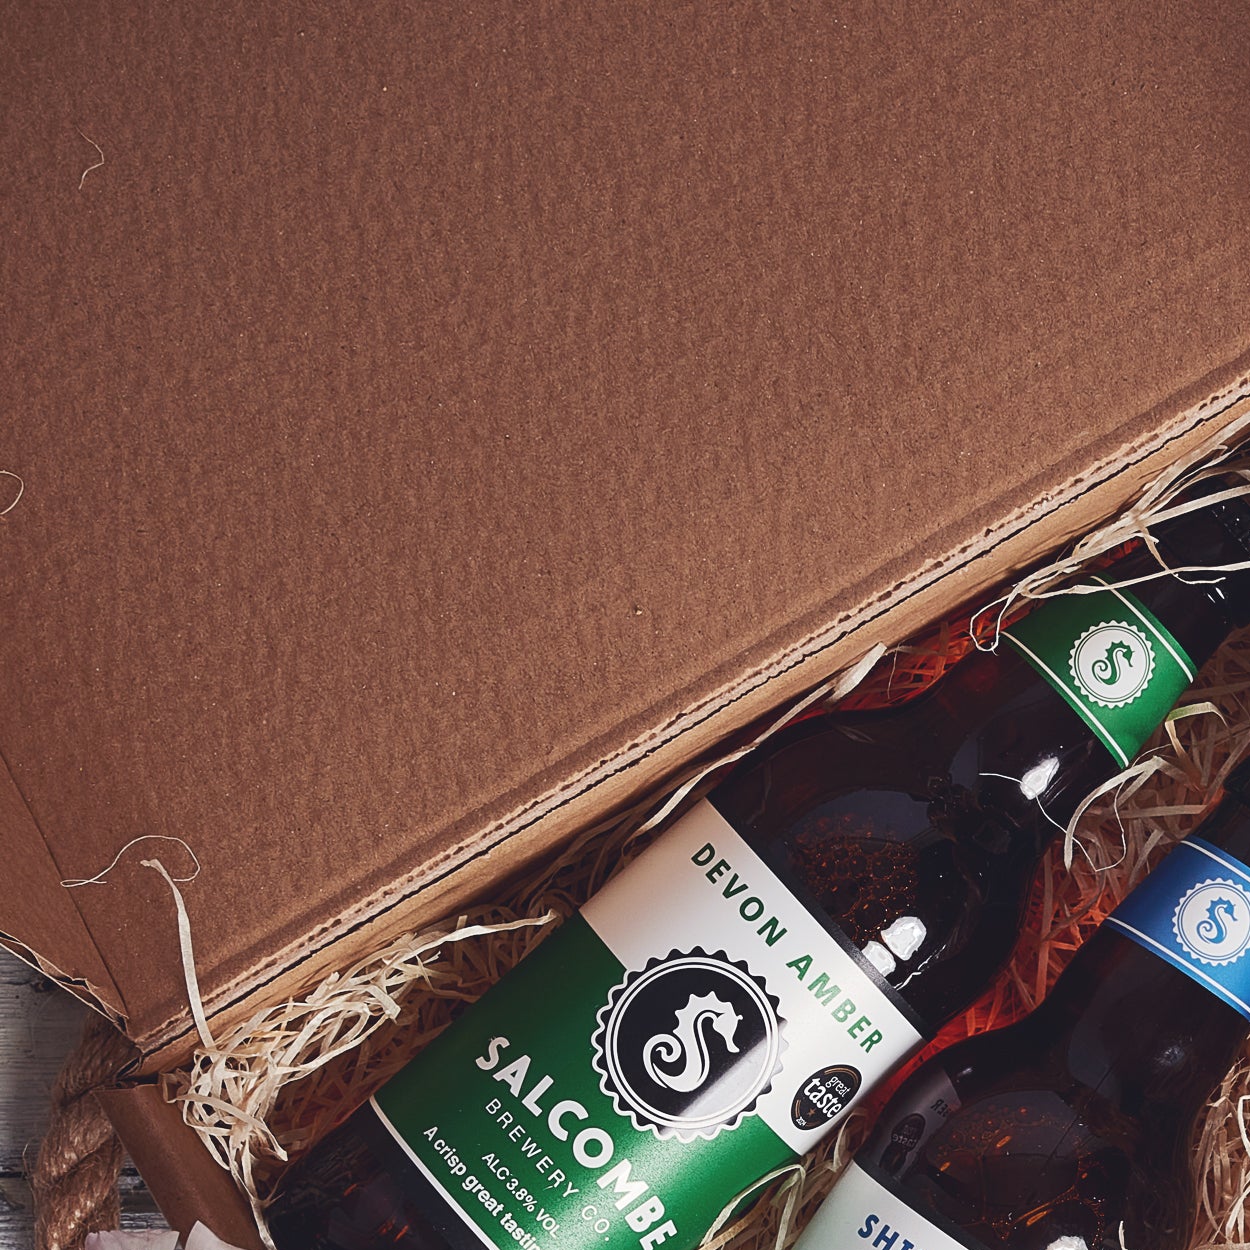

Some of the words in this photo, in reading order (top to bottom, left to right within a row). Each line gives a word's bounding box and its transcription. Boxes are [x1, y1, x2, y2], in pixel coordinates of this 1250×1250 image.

[691, 843, 787, 947] DEVON
[786, 954, 883, 1053] AMBER
[803, 1077, 842, 1118] taste
[825, 1076, 851, 1098] great
[423, 1126, 439, 1141] A
[434, 1140, 467, 1176] crisp
[462, 1173, 505, 1217] great
[481, 1151, 510, 1181] ALC
[506, 1177, 537, 1212] 3.8%
[535, 1208, 562, 1238] VOL
[485, 1098, 579, 1198] BREWERY
[581, 1205, 610, 1242] CO.
